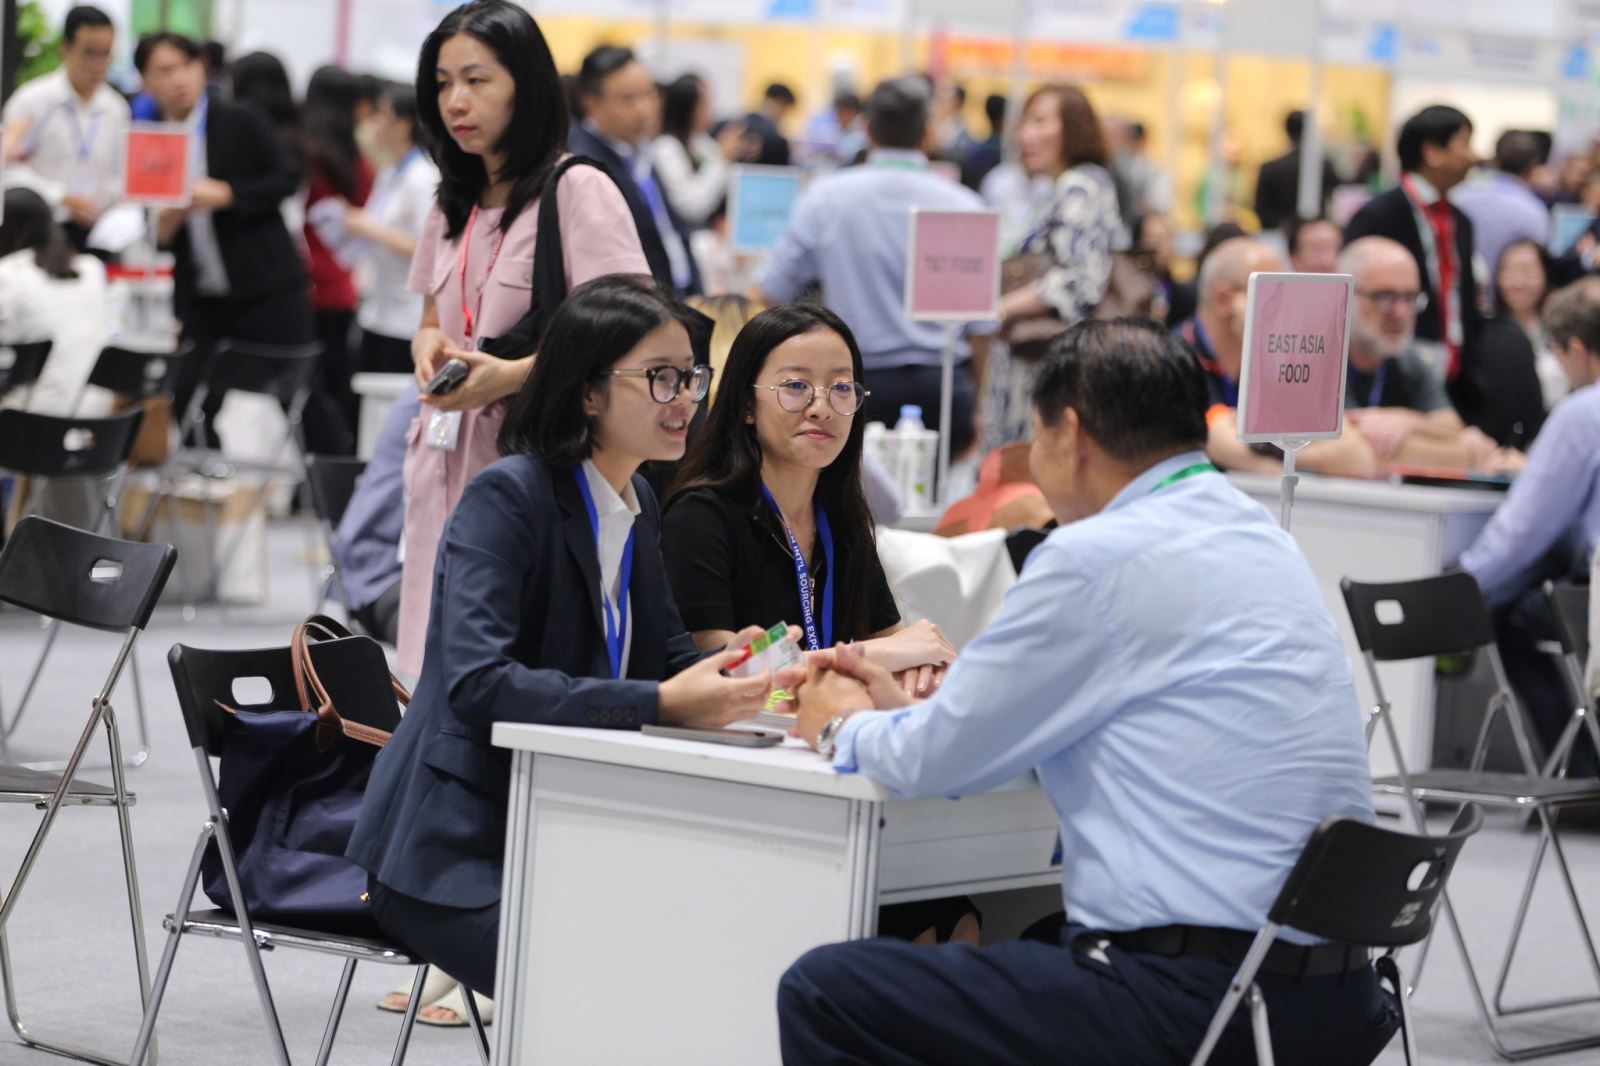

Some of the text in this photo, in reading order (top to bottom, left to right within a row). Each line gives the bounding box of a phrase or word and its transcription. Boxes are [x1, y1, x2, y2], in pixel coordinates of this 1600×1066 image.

[1267, 334, 1325, 354] EAST ASIA
[1278, 363, 1310, 383] FOOD
[799, 573, 812, 624] SOURCING
